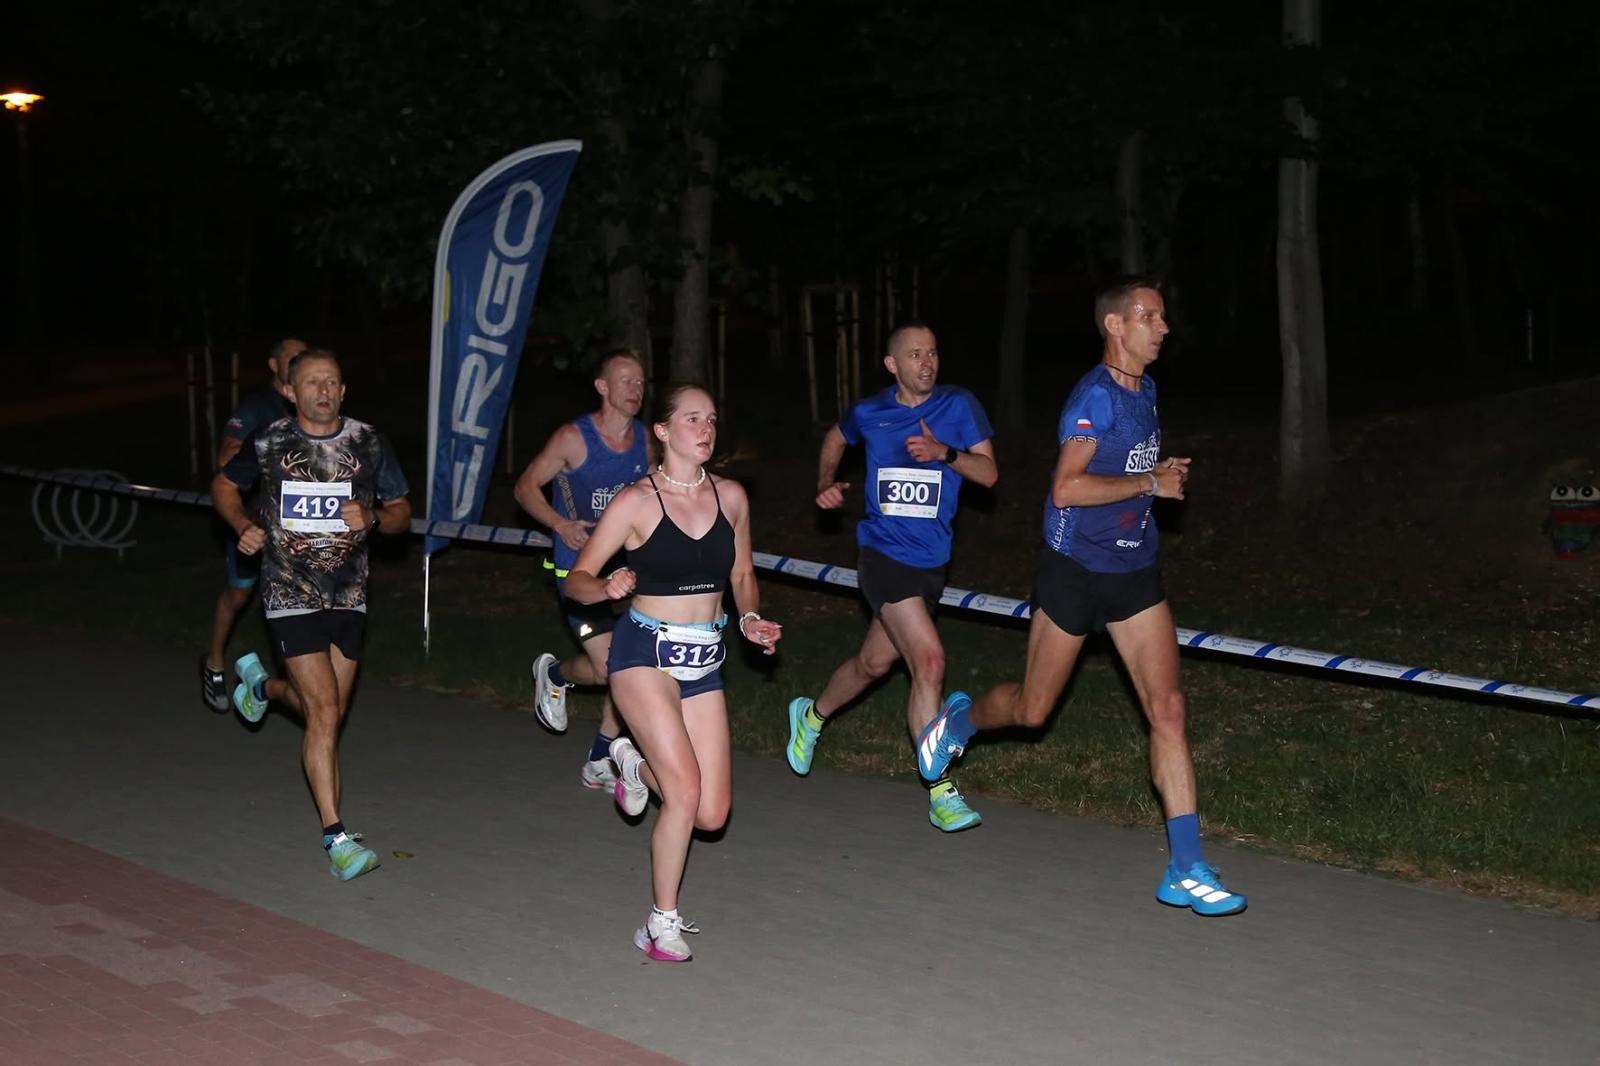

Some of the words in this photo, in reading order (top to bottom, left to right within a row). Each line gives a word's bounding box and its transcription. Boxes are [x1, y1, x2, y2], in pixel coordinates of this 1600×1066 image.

[887, 481, 930, 504] 300
[292, 496, 340, 518] 419
[678, 583, 715, 591] carpatree
[669, 644, 719, 666] 312
